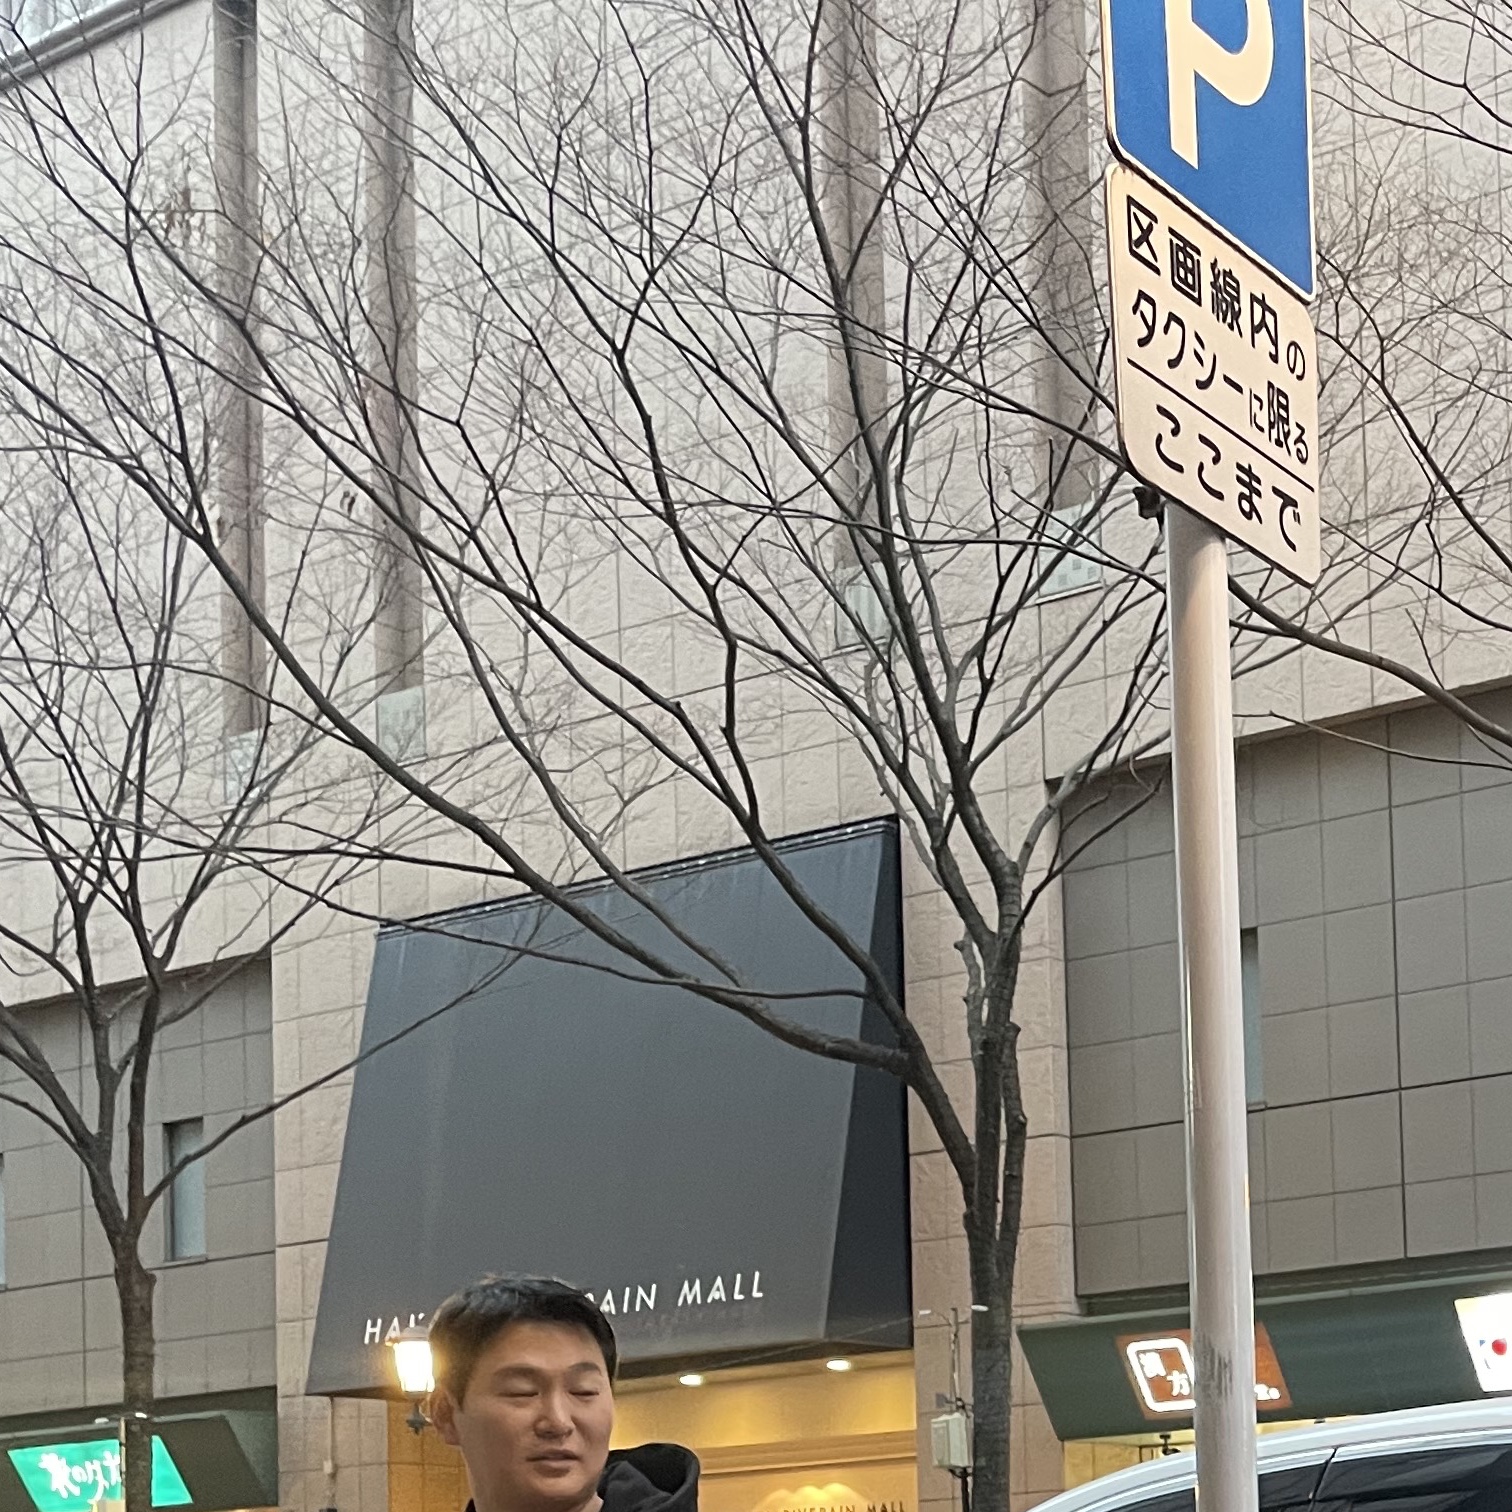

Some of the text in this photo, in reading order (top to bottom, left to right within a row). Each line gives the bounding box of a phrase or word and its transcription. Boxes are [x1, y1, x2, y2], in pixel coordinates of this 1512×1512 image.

[1165, 0, 1275, 170] P
[1126, 195, 1306, 381] 区画線内の
[1131, 289, 1309, 464] タクシーに限る
[1155, 403, 1302, 553] ここまで
[677, 1270, 764, 1307] MALL
